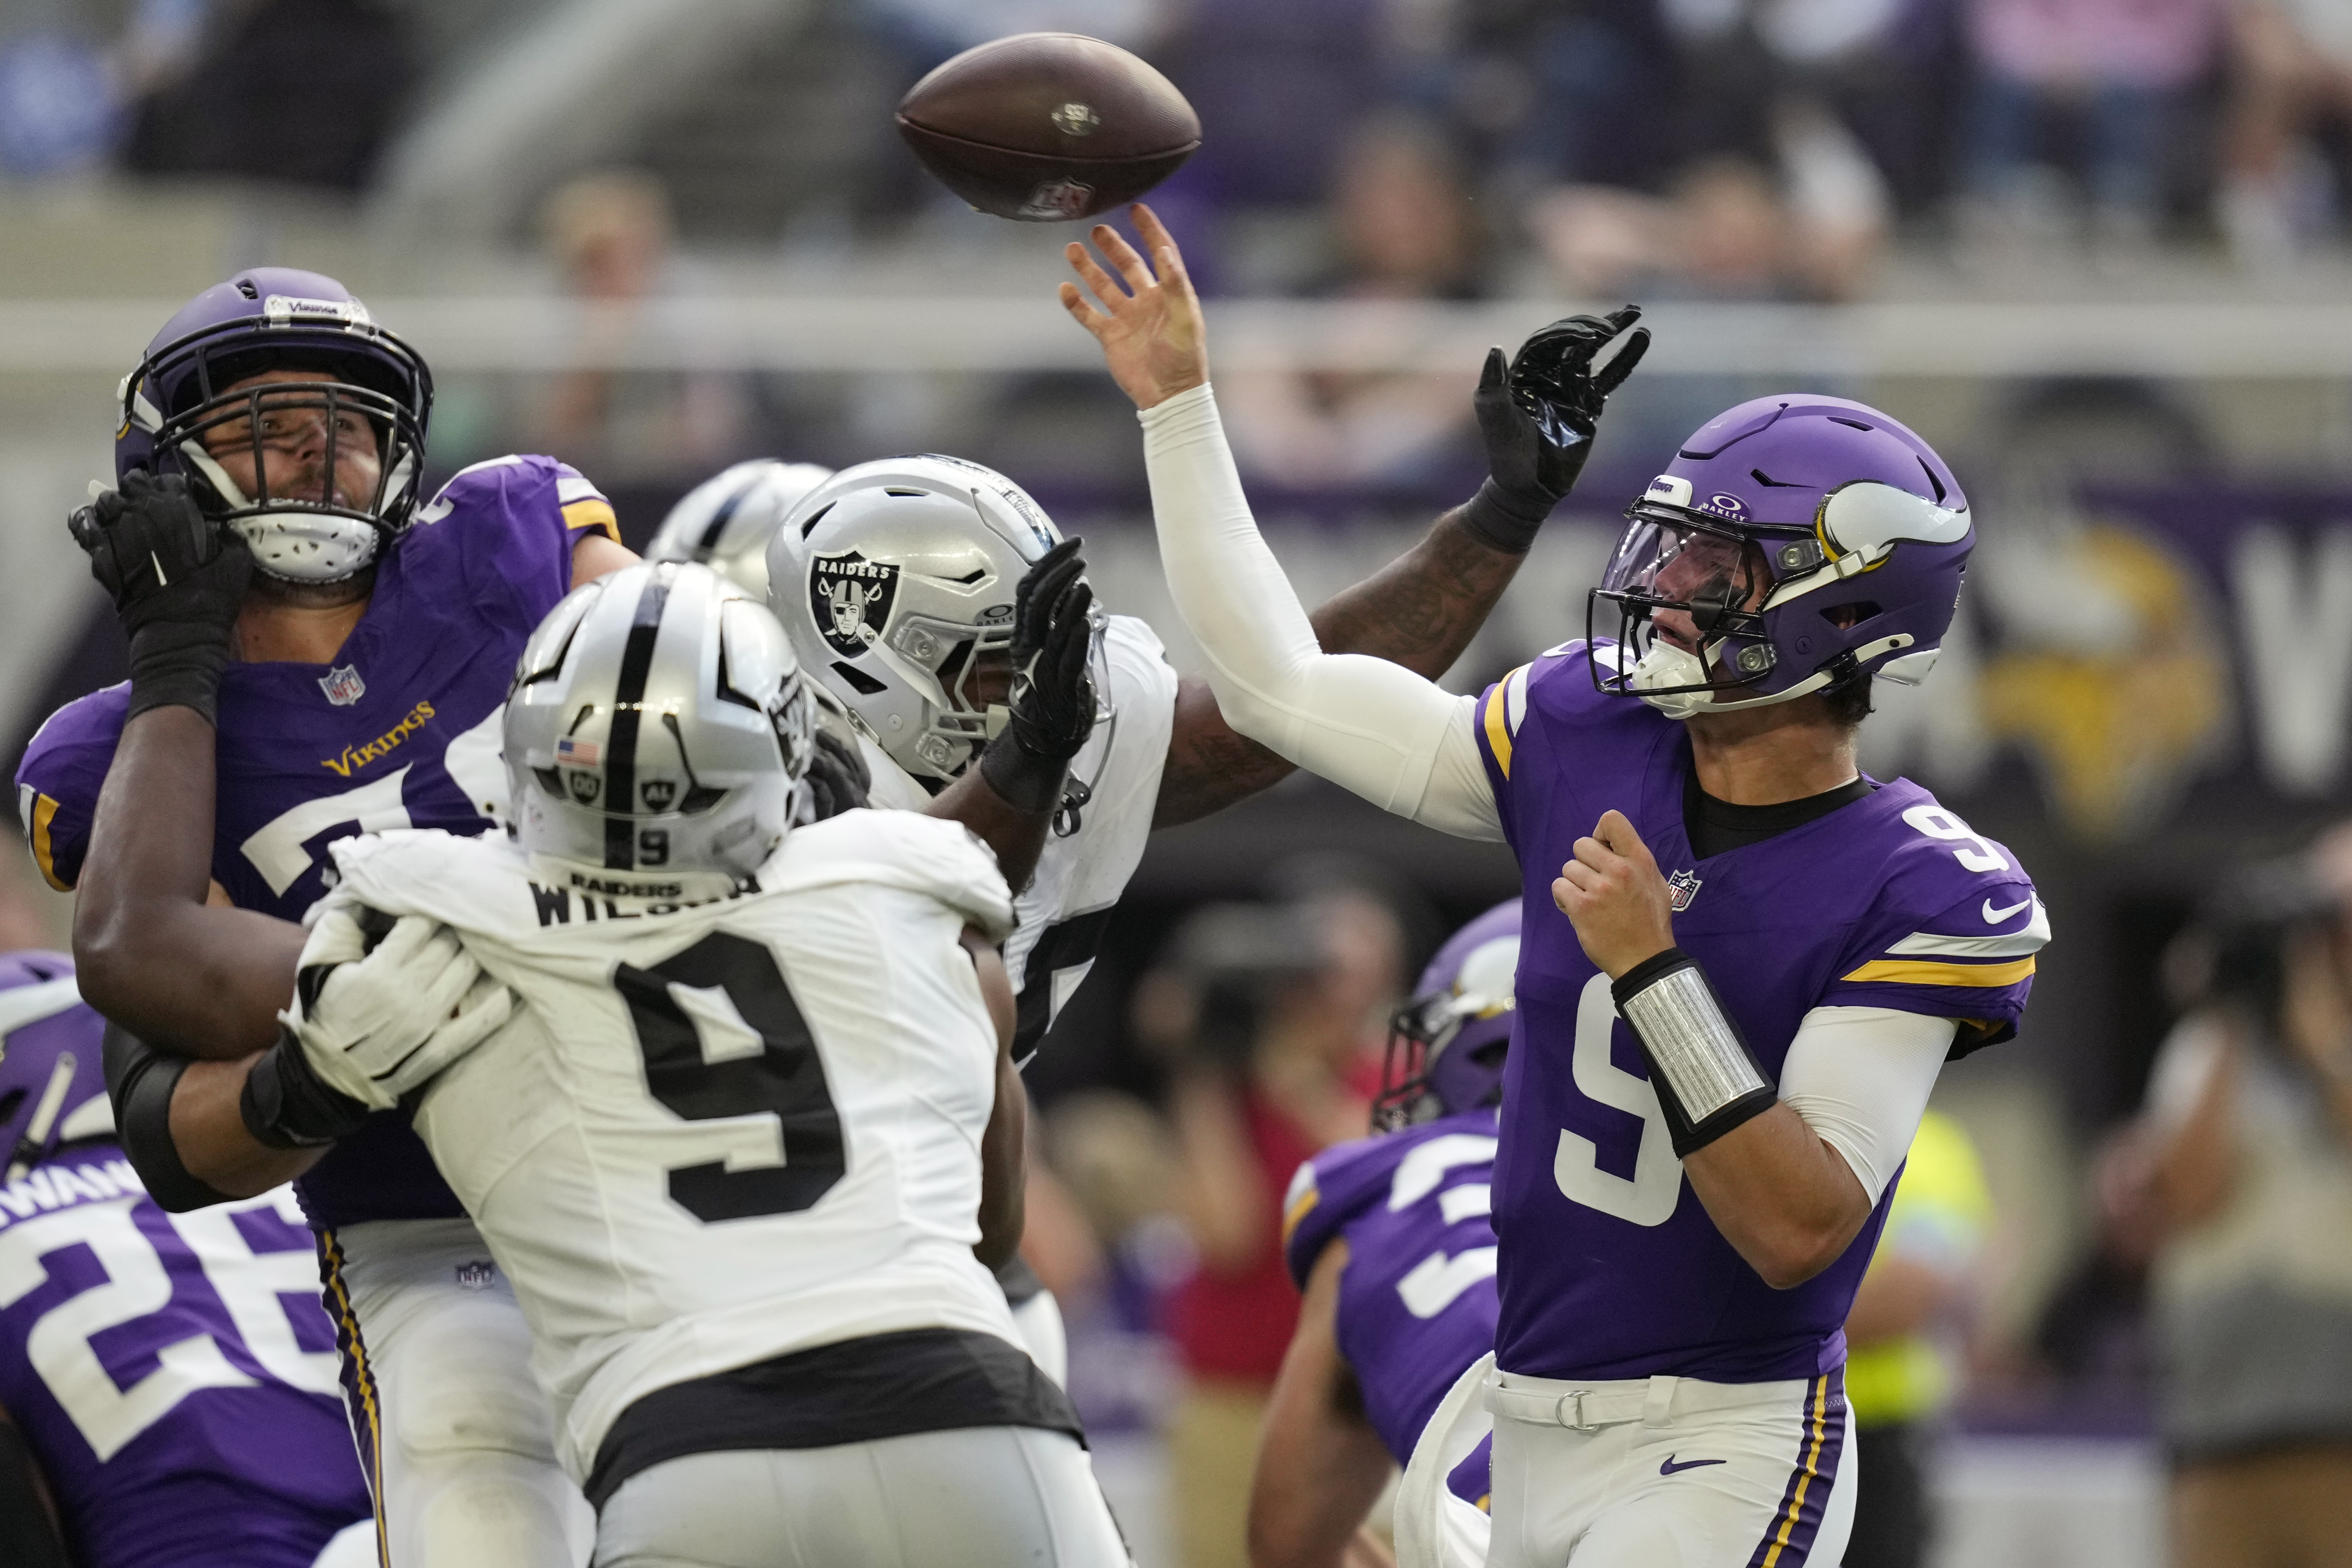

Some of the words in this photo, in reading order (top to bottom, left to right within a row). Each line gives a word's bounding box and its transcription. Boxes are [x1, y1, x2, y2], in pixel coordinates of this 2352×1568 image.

[1702, 503, 1745, 522] OAKLEY
[818, 560, 891, 579] RAIDERS
[640, 829, 670, 866] 9
[1902, 805, 2009, 872] 9
[571, 872, 683, 897] RAIDERS
[613, 929, 848, 1224] 9
[1554, 972, 1684, 1227] 9
